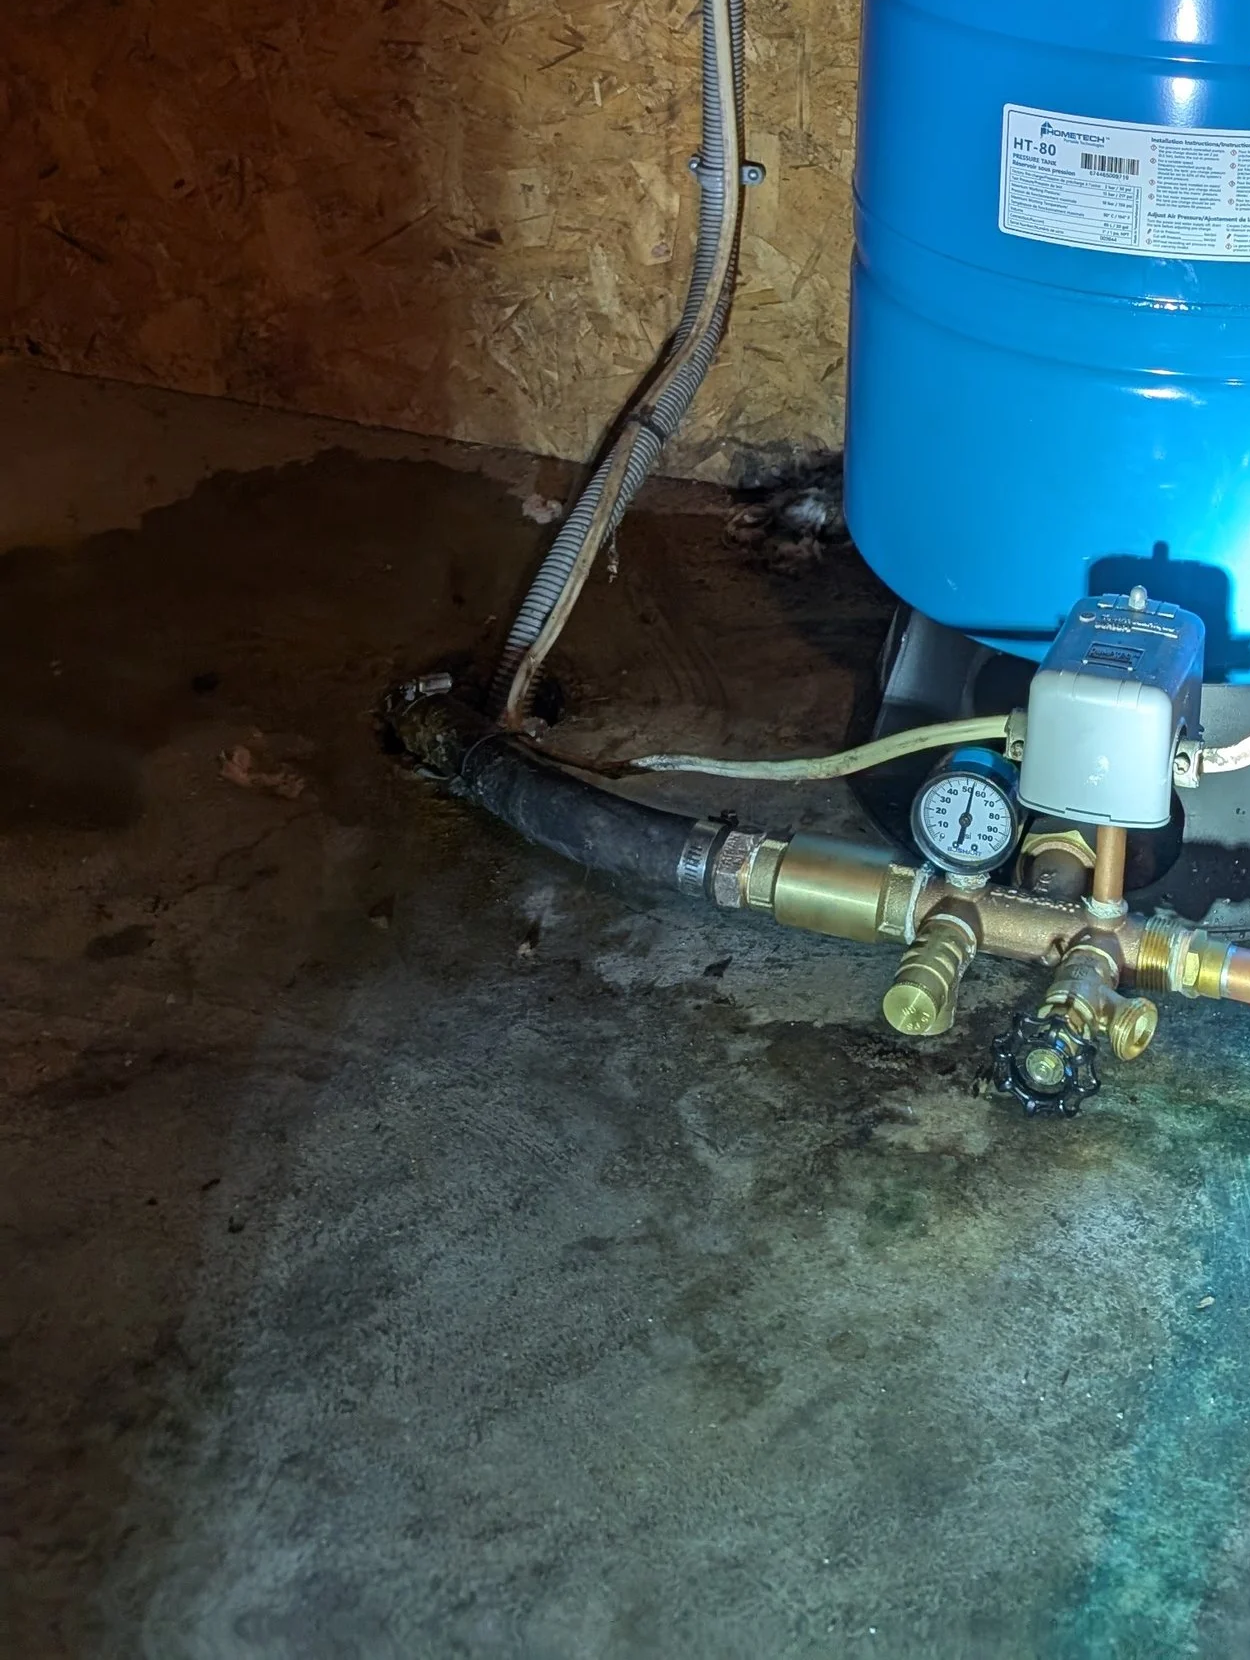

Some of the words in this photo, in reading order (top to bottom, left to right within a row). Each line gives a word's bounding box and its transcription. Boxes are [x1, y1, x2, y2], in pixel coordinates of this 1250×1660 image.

[1047, 128, 1105, 143] HOMETECH
[1151, 137, 1183, 145] Installation
[1013, 137, 1056, 156] HT-80
[1013, 153, 1040, 163] PRESSURE
[1041, 158, 1057, 166] TANK
[1012, 159, 1037, 170] Réservoir
[1052, 166, 1076, 177] pression
[940, 796, 951, 804] 30
[936, 807, 947, 815] 20
